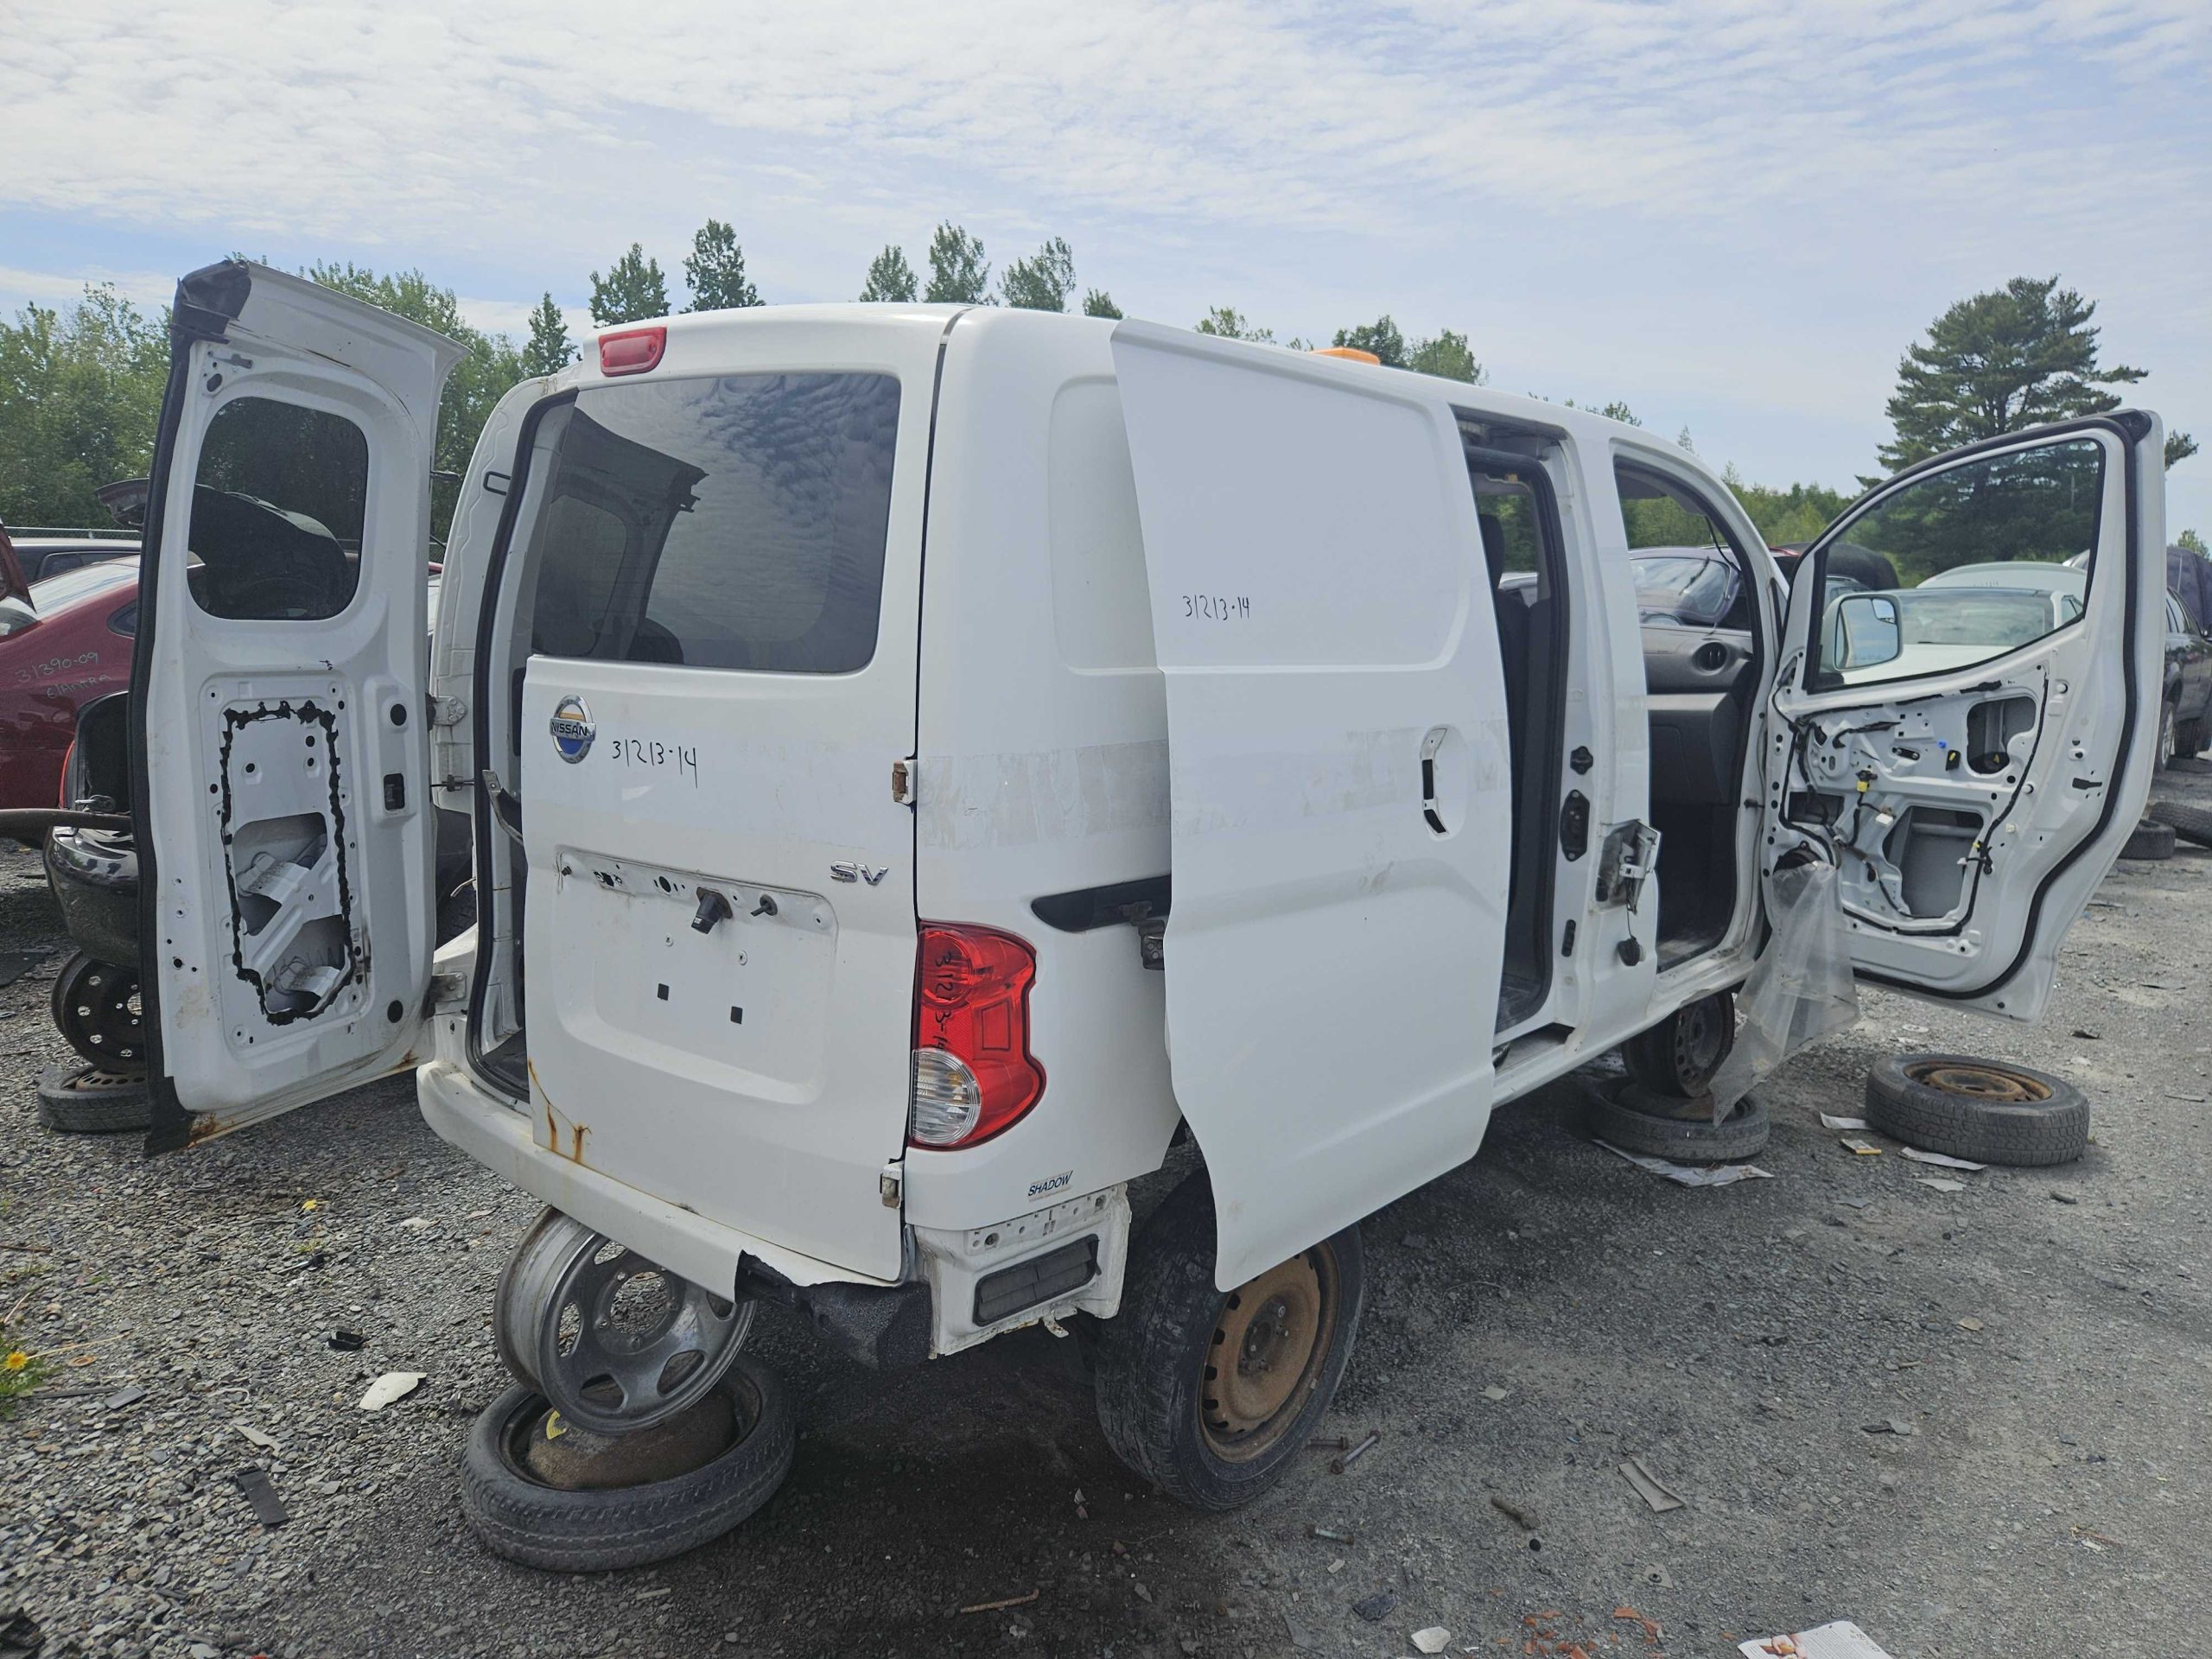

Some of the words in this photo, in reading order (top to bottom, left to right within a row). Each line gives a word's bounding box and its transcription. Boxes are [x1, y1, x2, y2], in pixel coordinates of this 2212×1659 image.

[15, 652, 98, 683] 31390-09
[550, 721, 588, 736] NISSAN
[830, 861, 888, 887] SV
[1027, 1170, 1073, 1197] SHADOW
